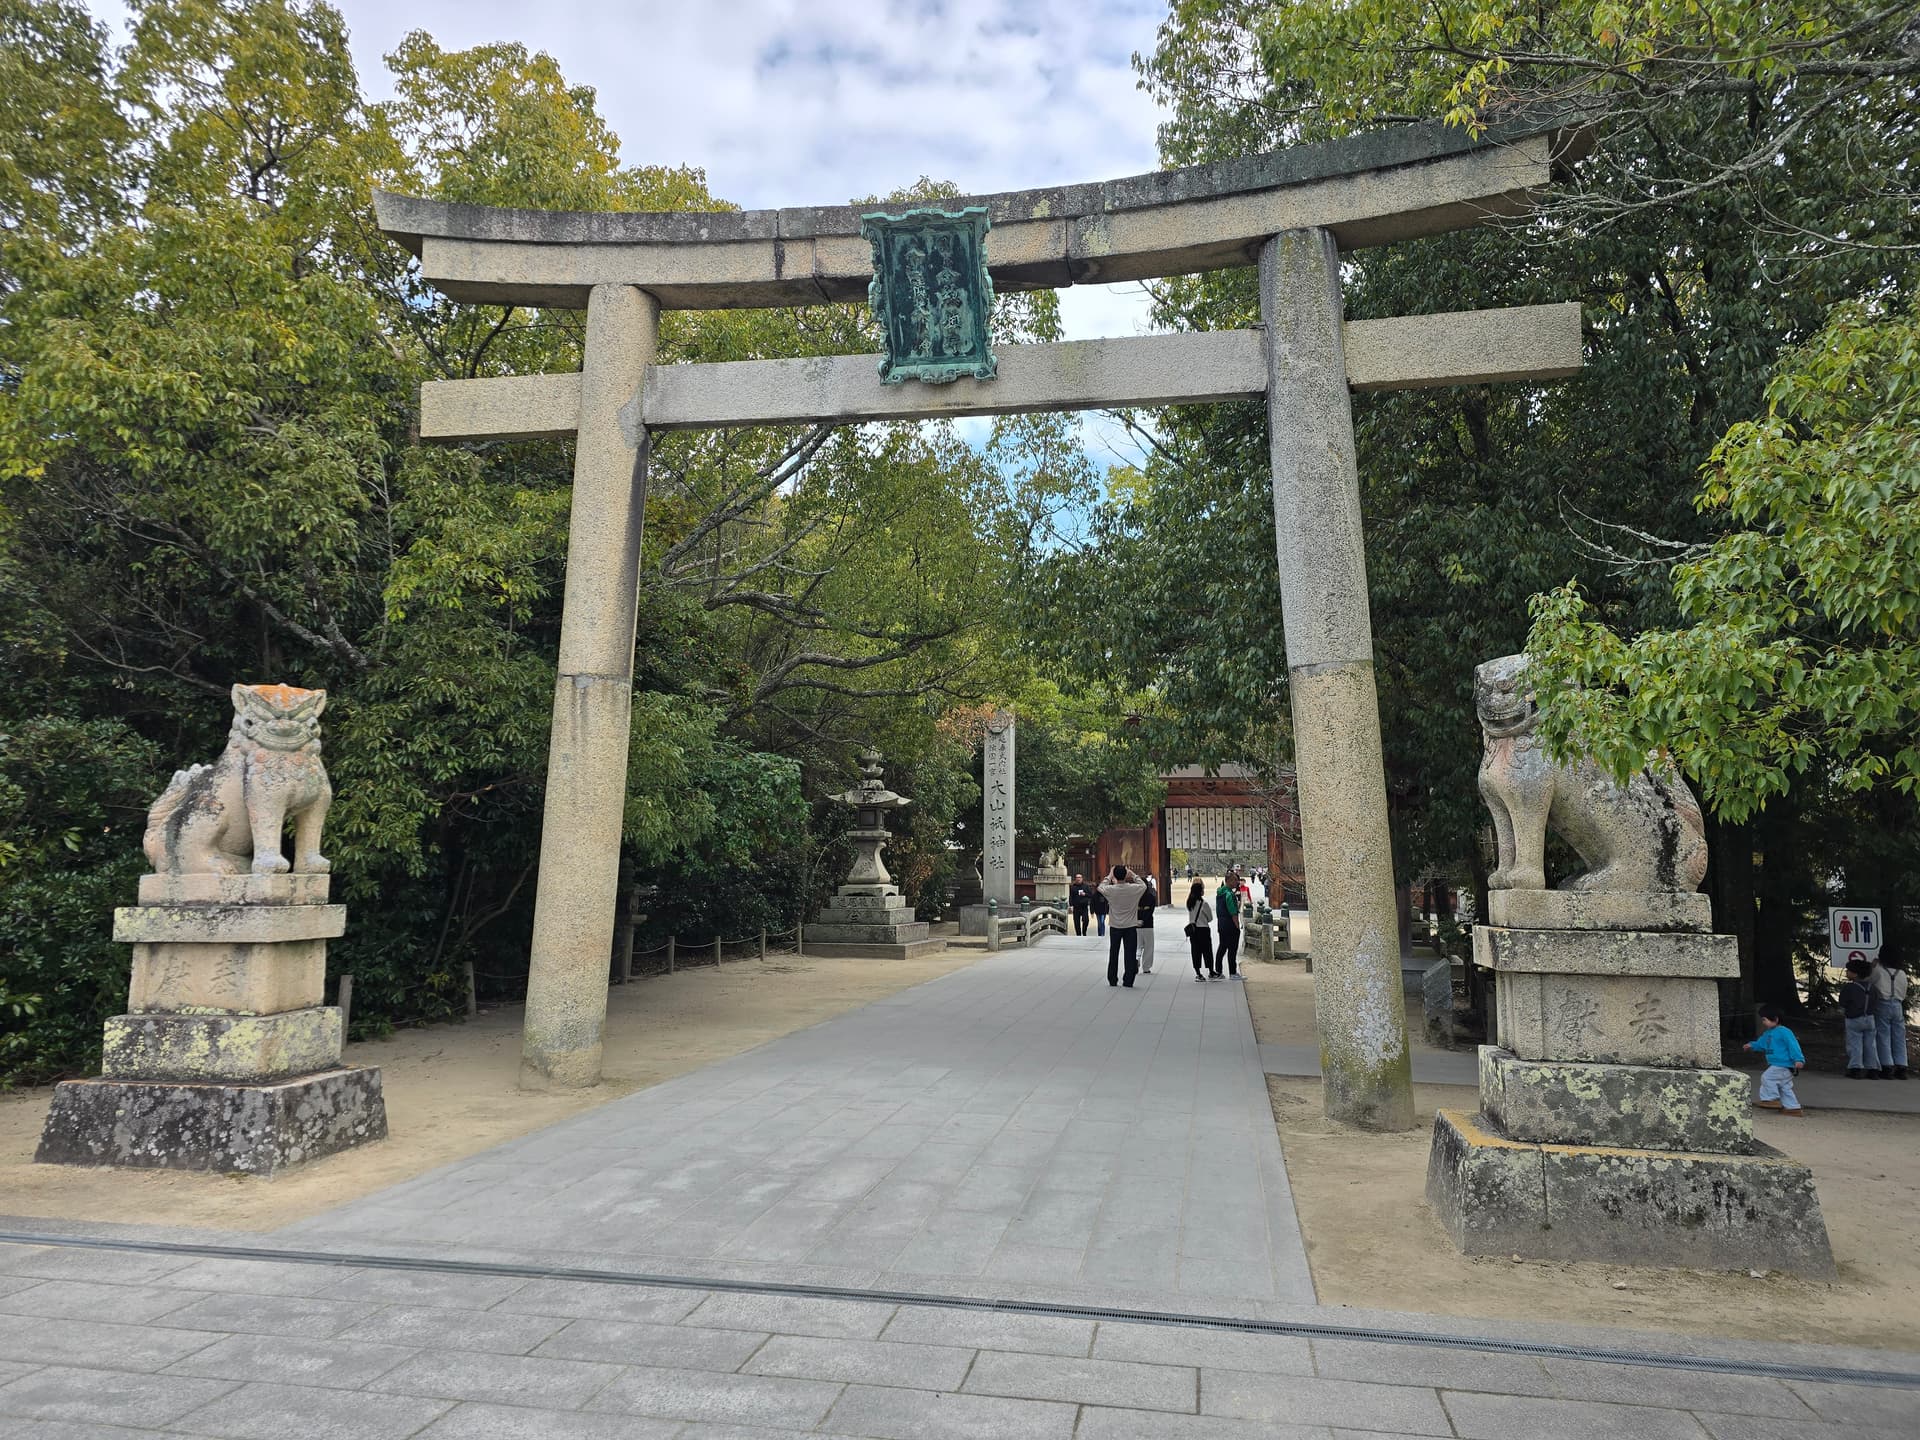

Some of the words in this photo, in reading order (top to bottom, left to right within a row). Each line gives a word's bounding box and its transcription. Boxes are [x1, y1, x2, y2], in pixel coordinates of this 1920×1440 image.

[989, 779, 1007, 871] 大山祇神社
